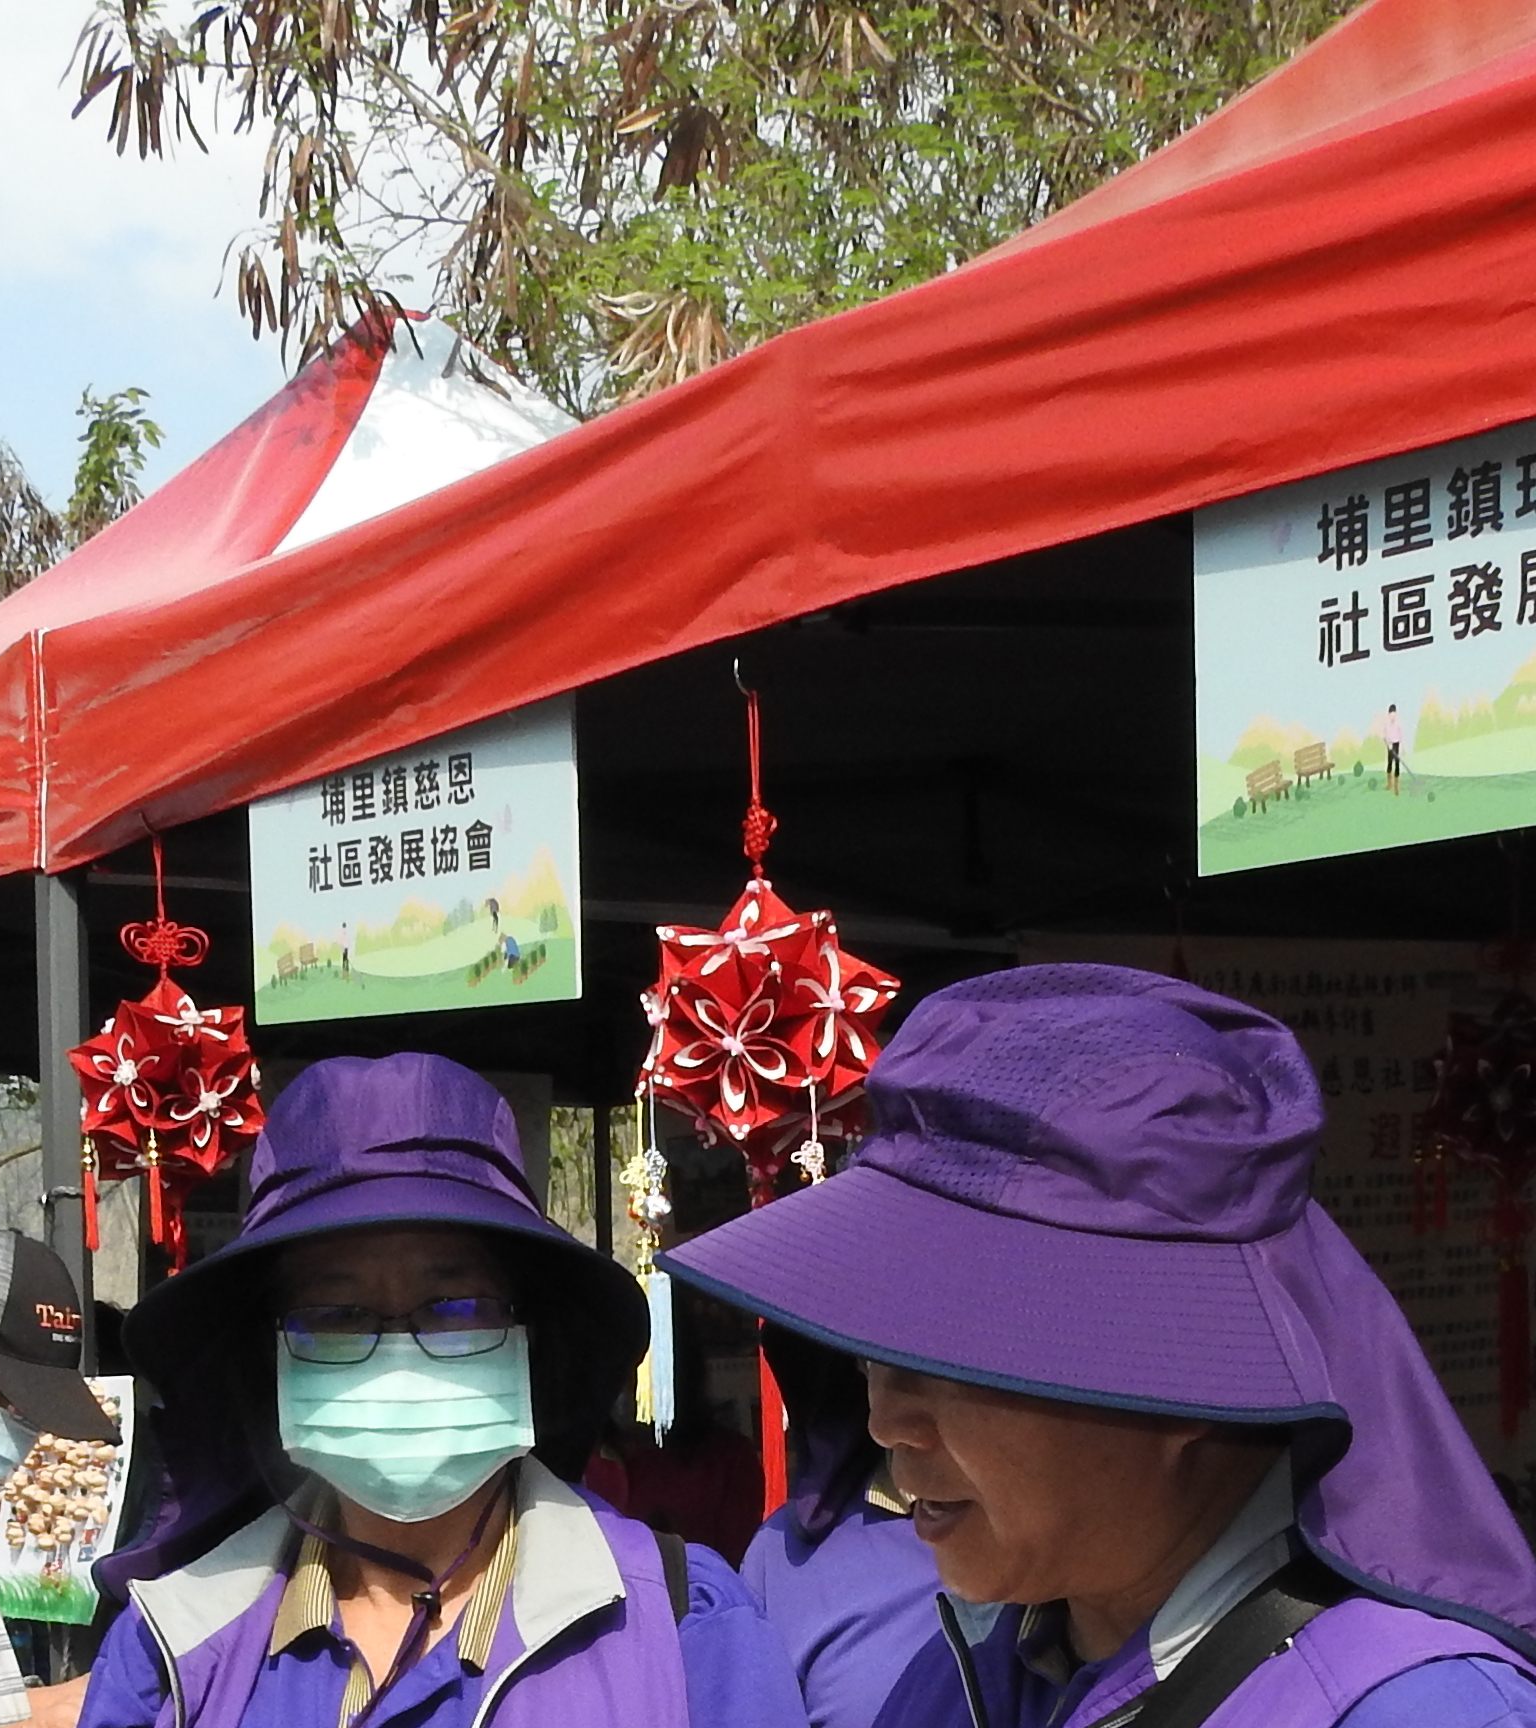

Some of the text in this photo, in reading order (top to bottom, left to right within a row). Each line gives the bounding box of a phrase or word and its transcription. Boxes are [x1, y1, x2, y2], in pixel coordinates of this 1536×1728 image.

[320, 751, 476, 828] 埔里鎮慈恩
[307, 819, 494, 894] 社區發展協會
